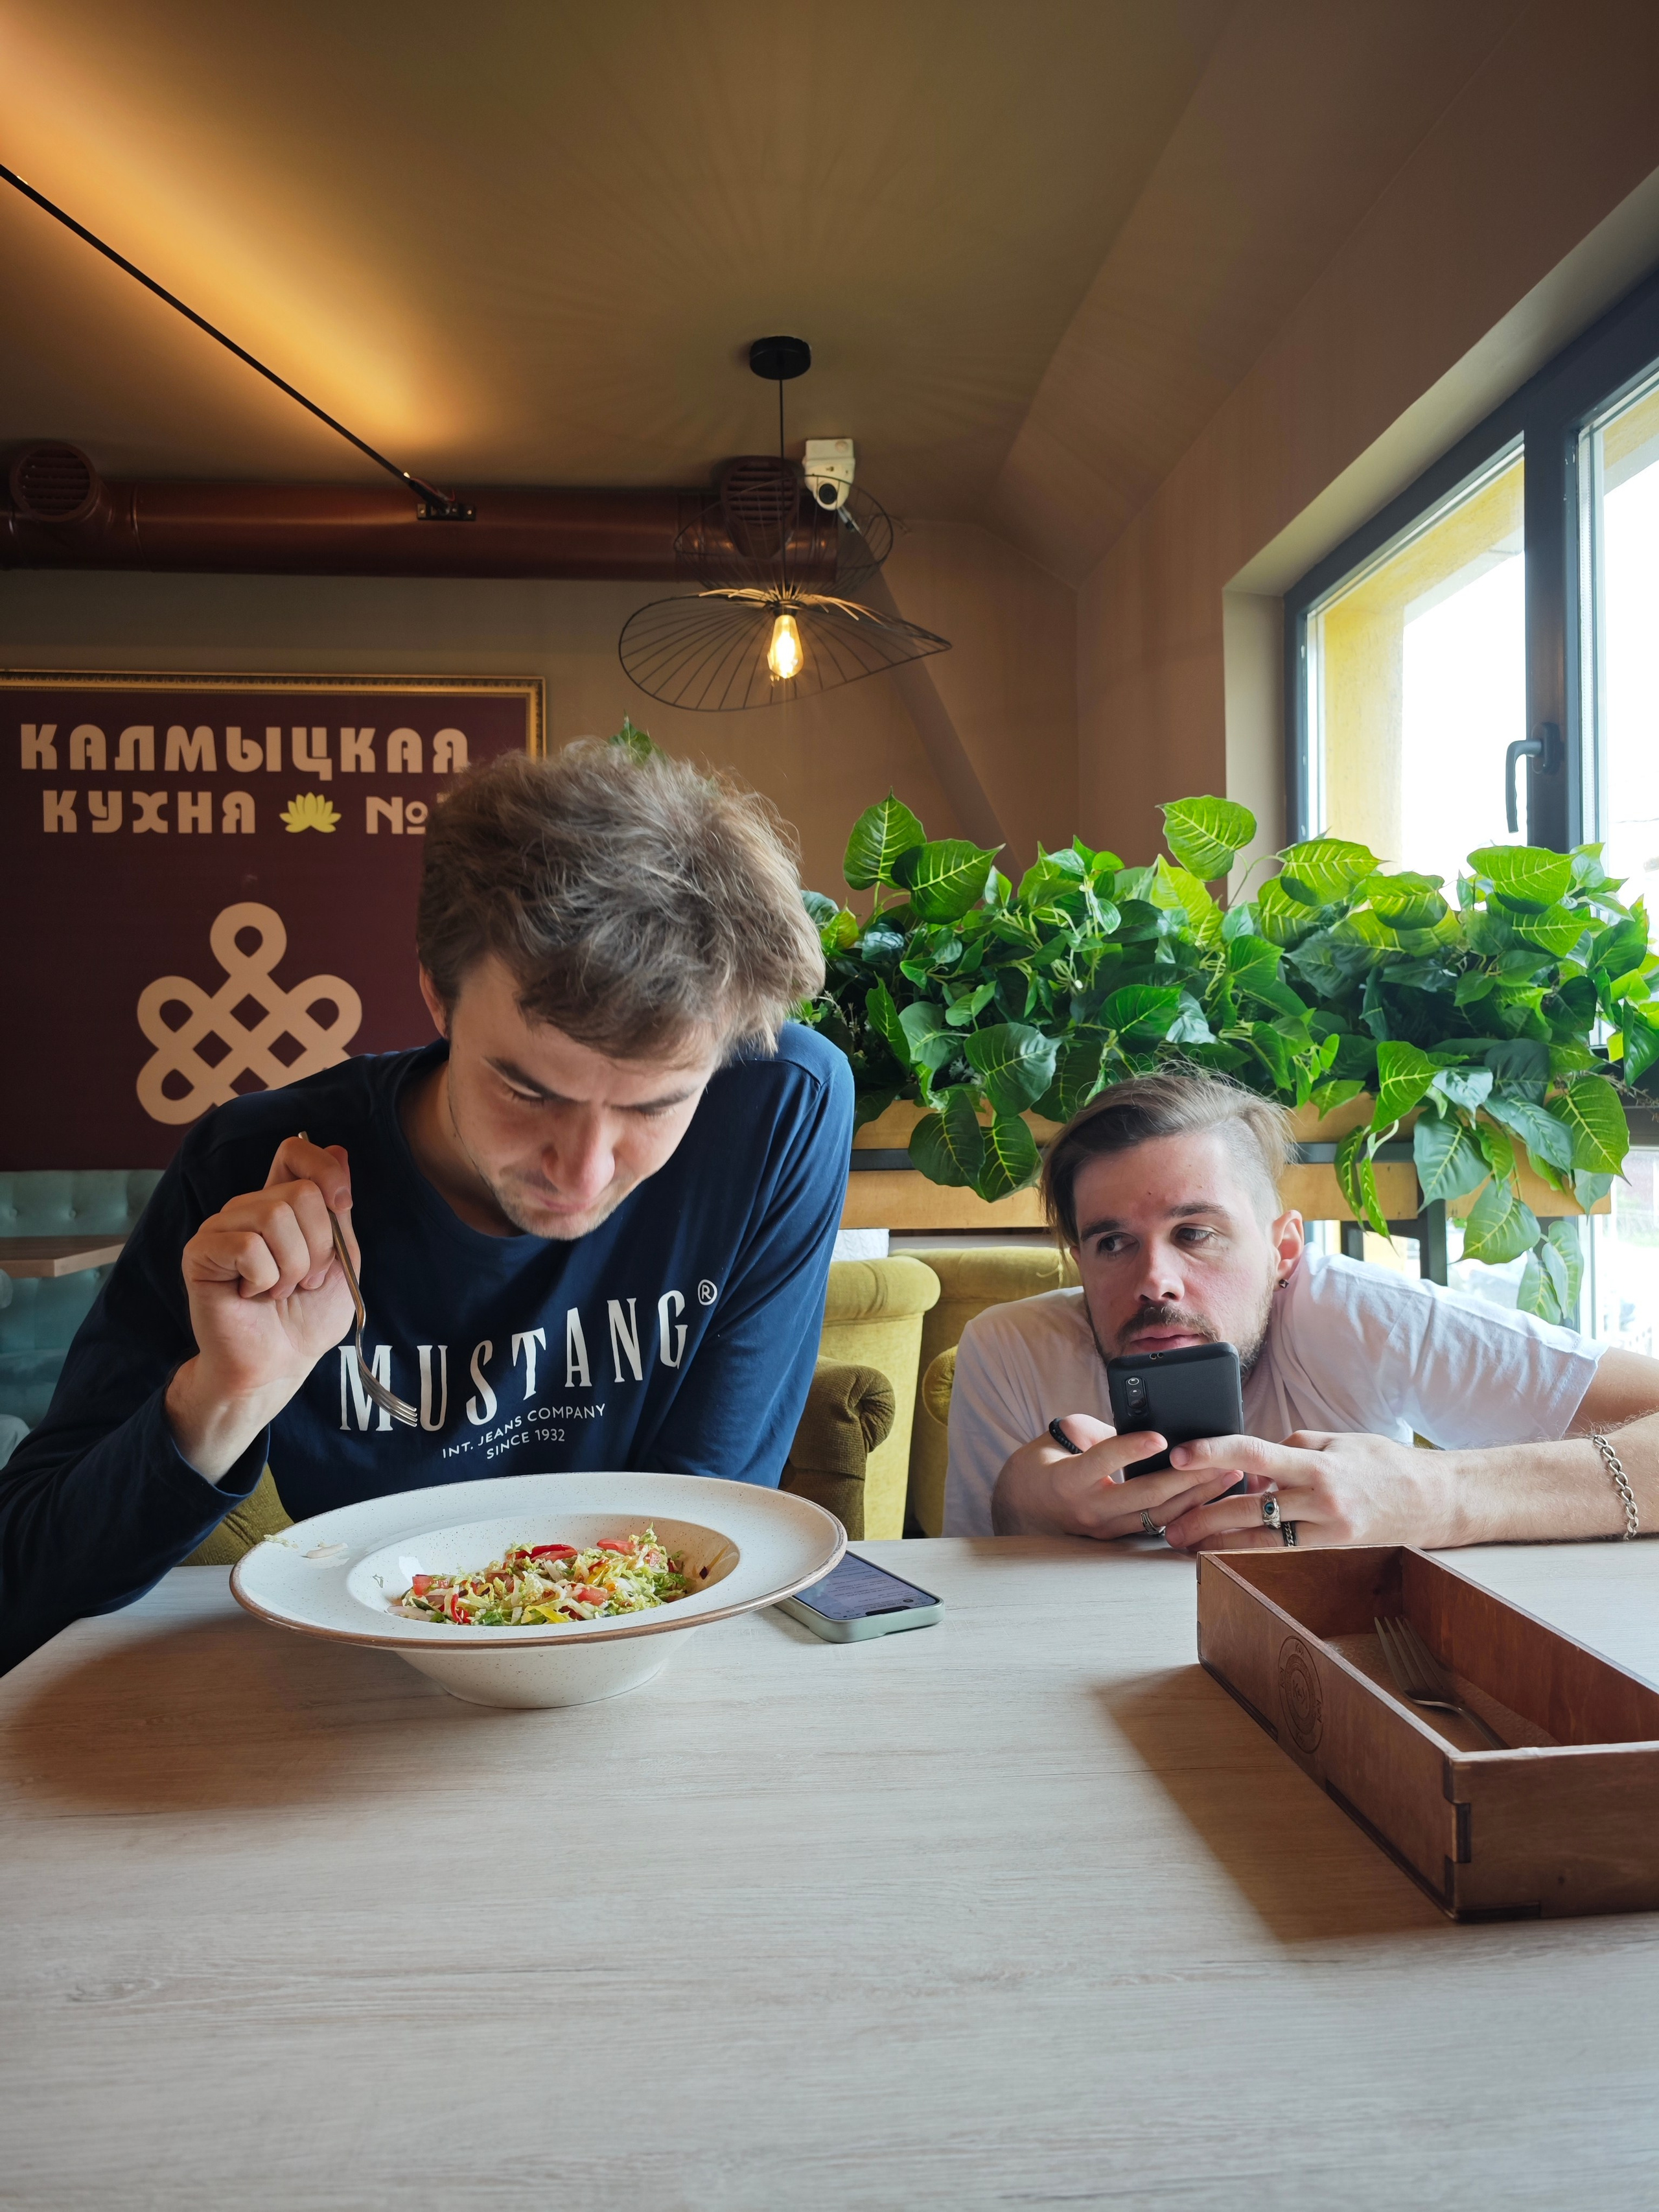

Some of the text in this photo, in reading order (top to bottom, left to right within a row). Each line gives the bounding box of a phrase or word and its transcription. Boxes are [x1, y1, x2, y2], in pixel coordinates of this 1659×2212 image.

[20, 723, 468, 780] КАЛМЫЦКАЯ
[43, 790, 256, 834] КУХНЯ
[442, 1403, 605, 1458] INT. JEANS COMPANY
[486, 1428, 565, 1460] SINCE 1932
